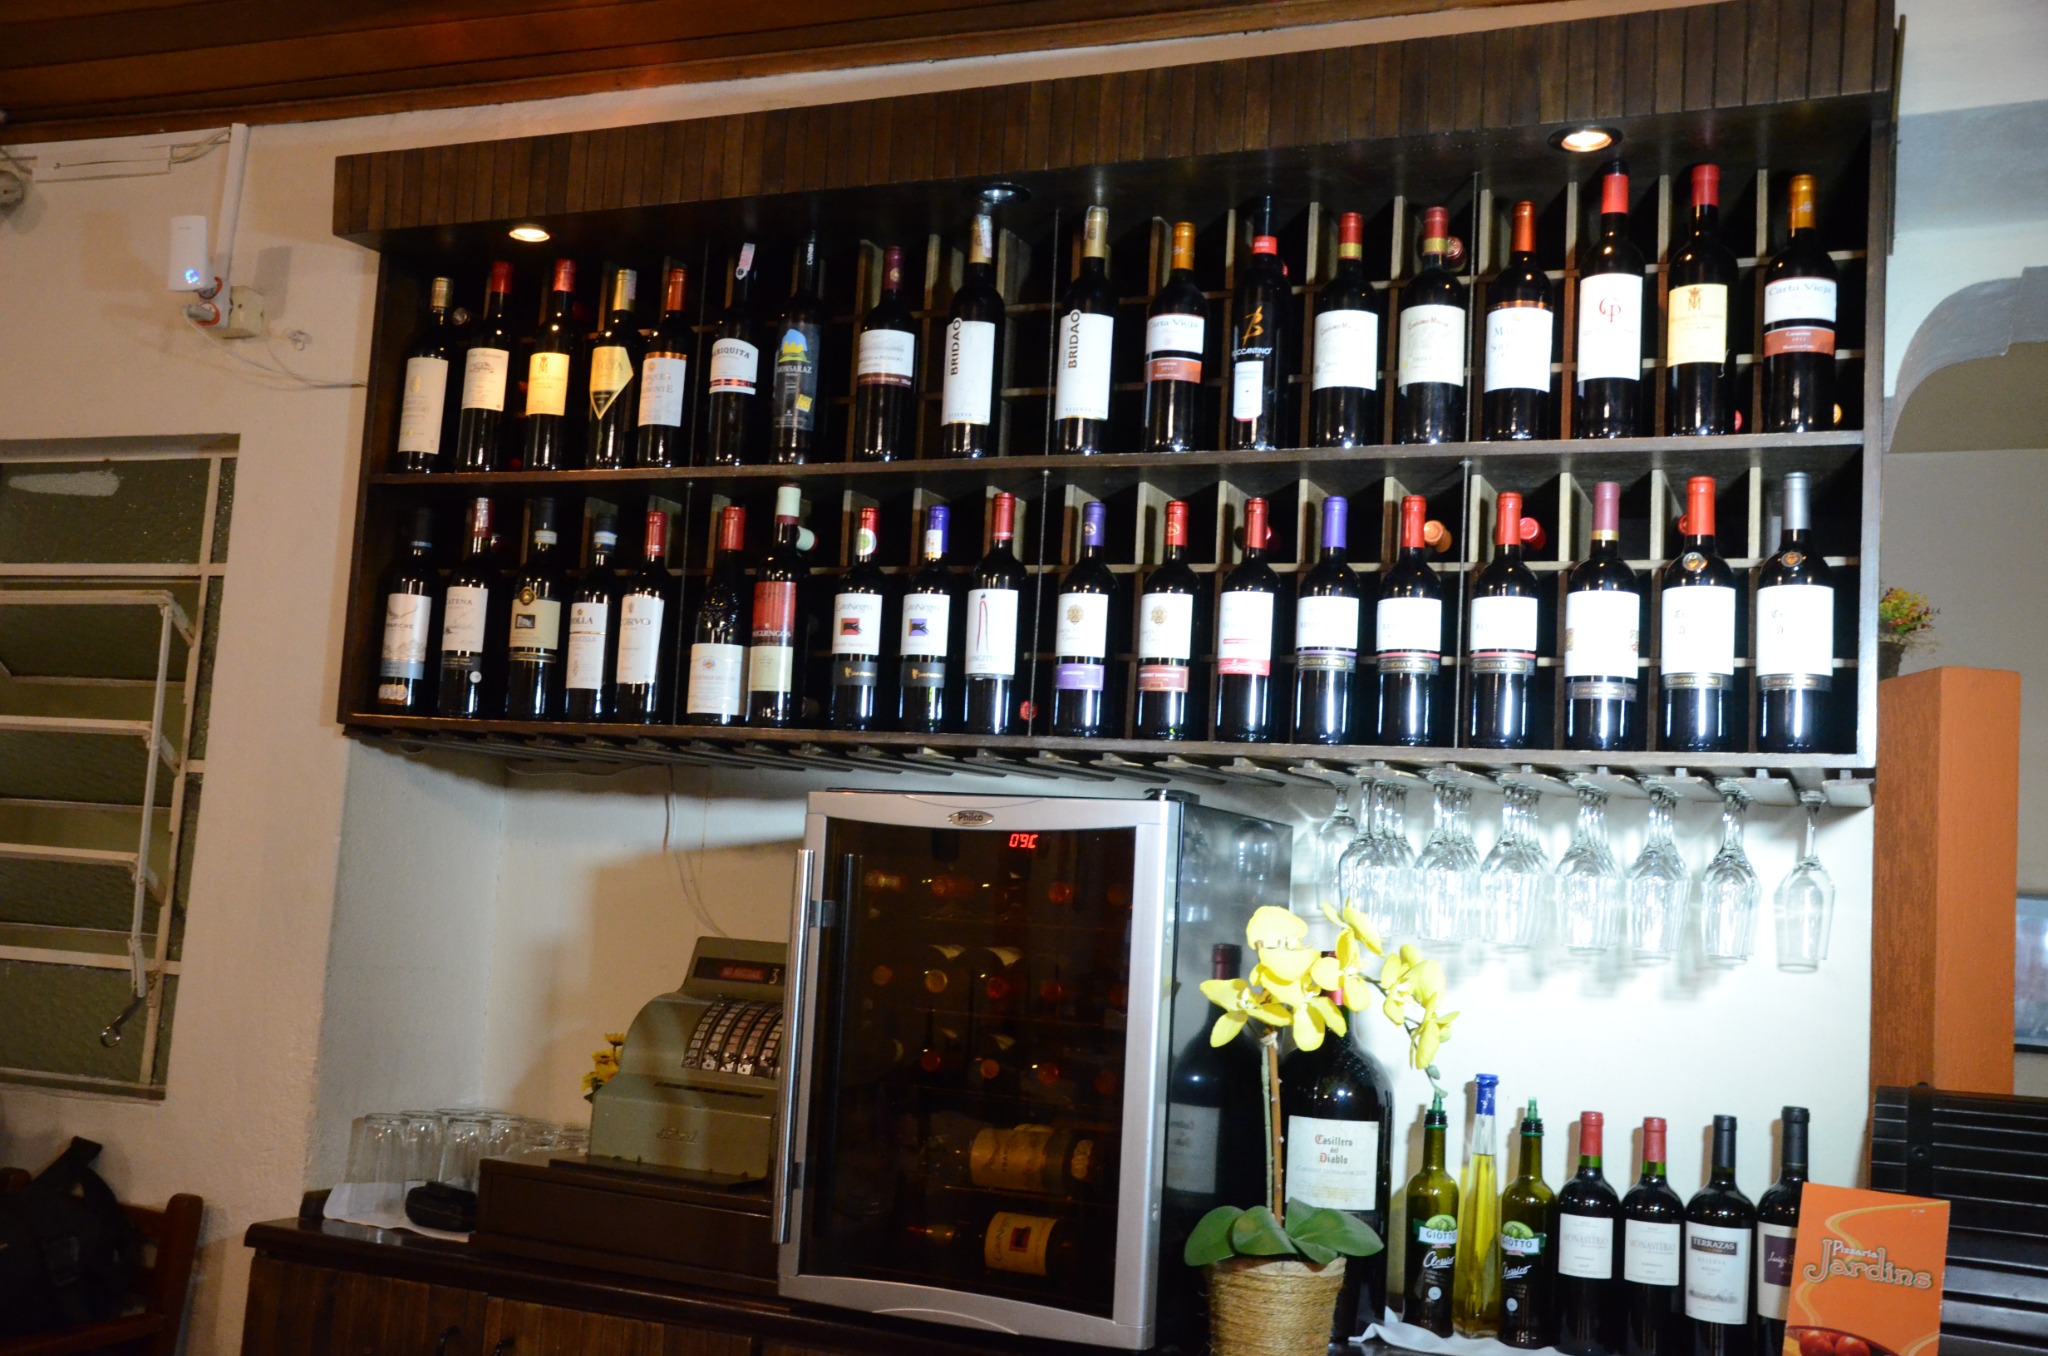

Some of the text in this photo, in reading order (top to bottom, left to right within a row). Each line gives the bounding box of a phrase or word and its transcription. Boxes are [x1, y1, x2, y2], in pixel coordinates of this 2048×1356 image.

[712, 347, 750, 359] RIQUITA
[446, 598, 473, 606] ATENA
[620, 617, 651, 627] ORVO
[957, 812, 984, 822] Philco
[1315, 1134, 1353, 1147] Casillero
[1319, 1152, 1348, 1165] Diablo
[1693, 1238, 1735, 1251] TERRAZAS
[1803, 1238, 1933, 1290] Jardins
